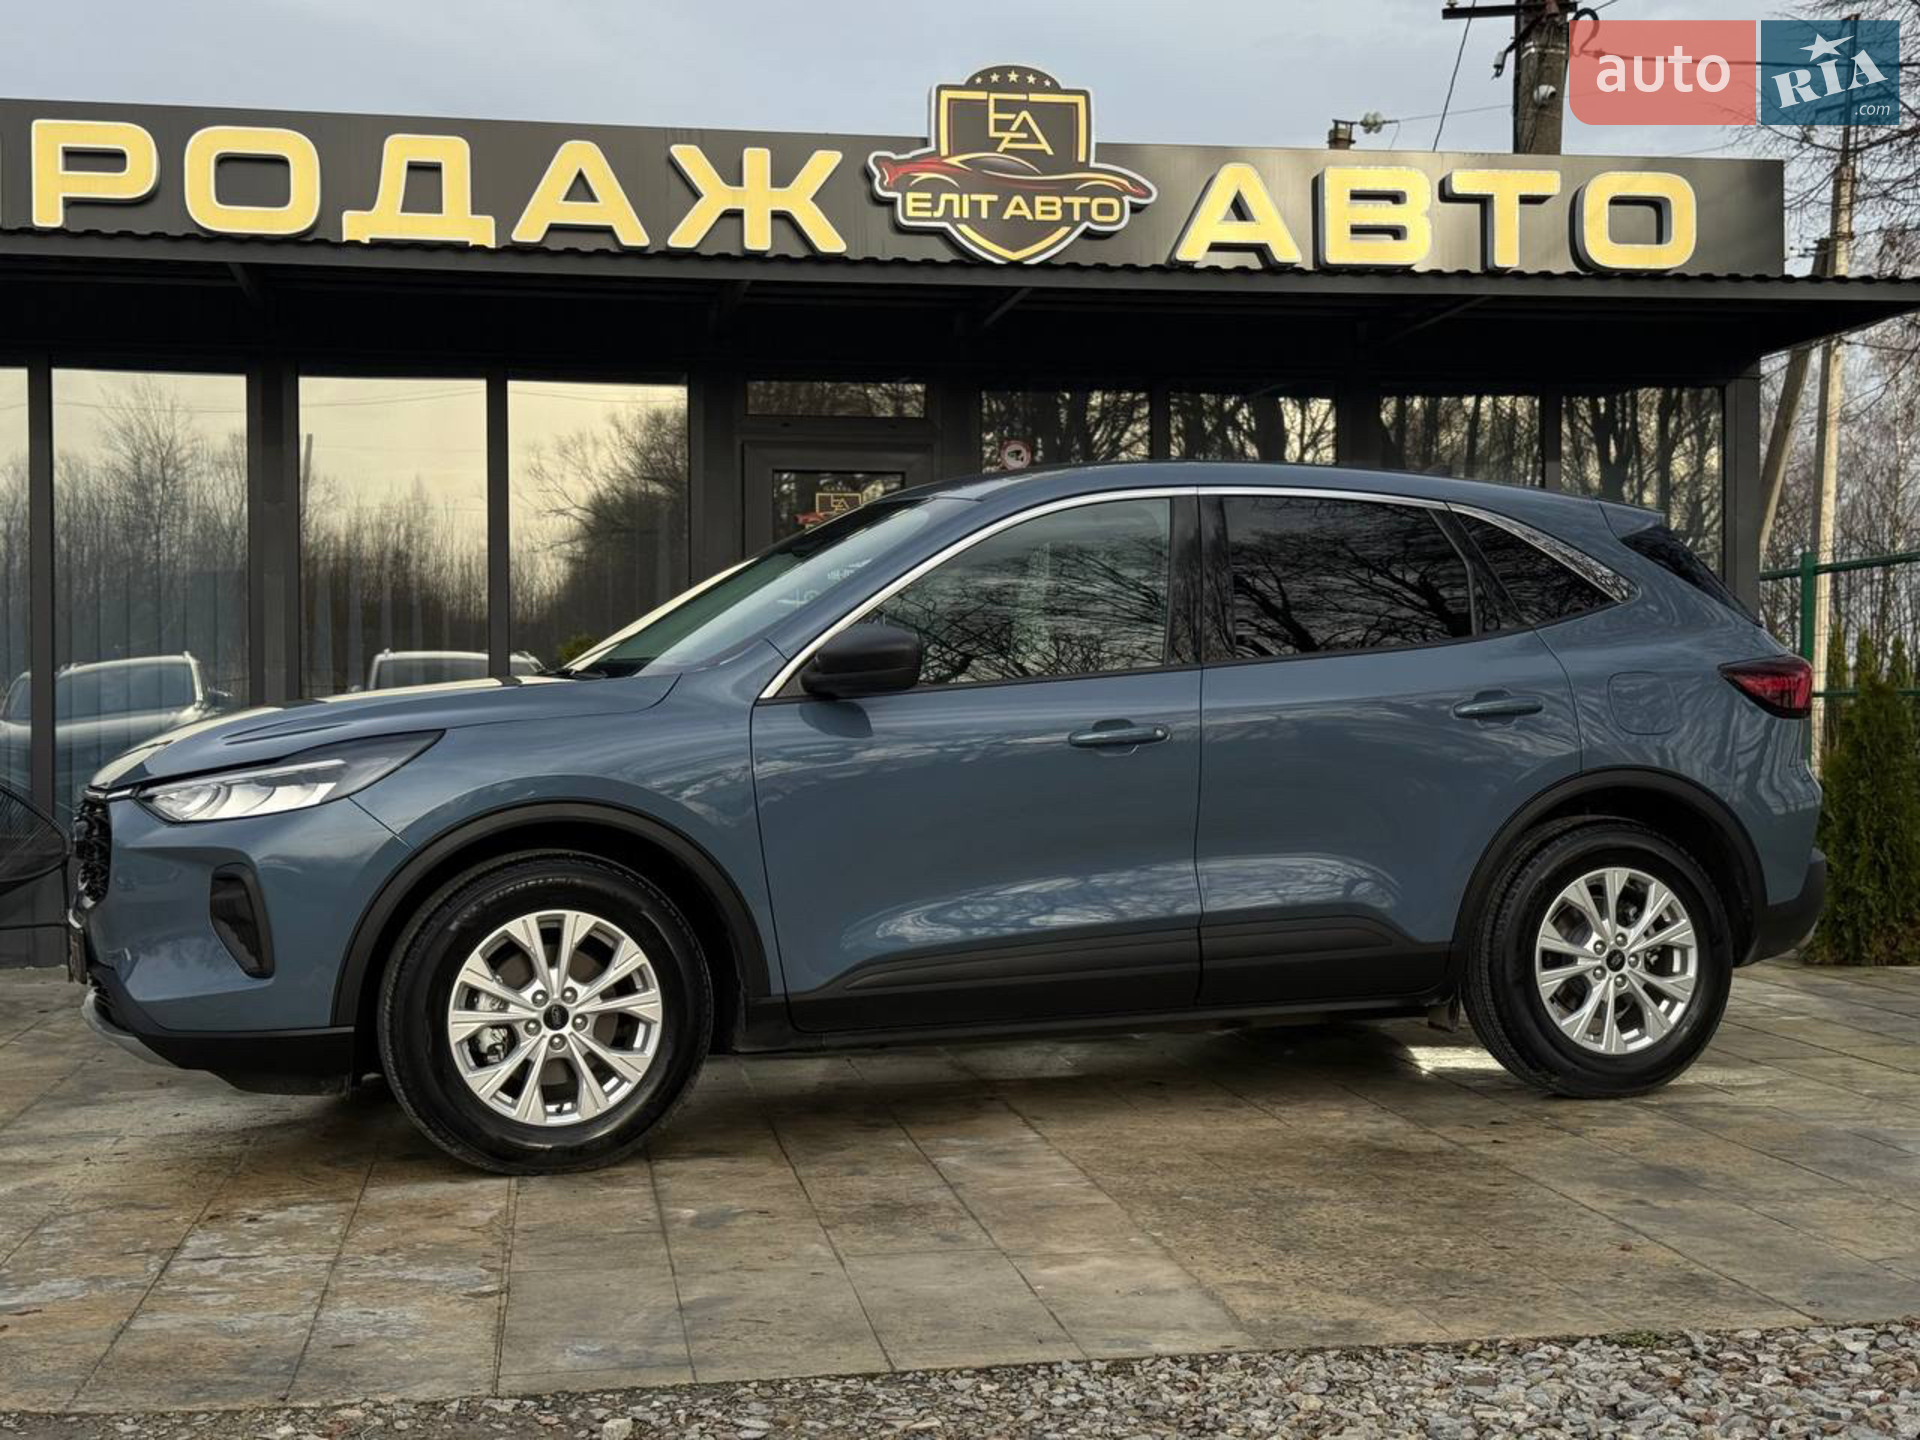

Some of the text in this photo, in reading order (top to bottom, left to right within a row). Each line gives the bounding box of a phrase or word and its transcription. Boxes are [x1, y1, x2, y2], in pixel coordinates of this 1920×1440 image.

[905, 192, 1121, 222] ЕЛІТ АВТО
[1174, 162, 1698, 271] АВТО
